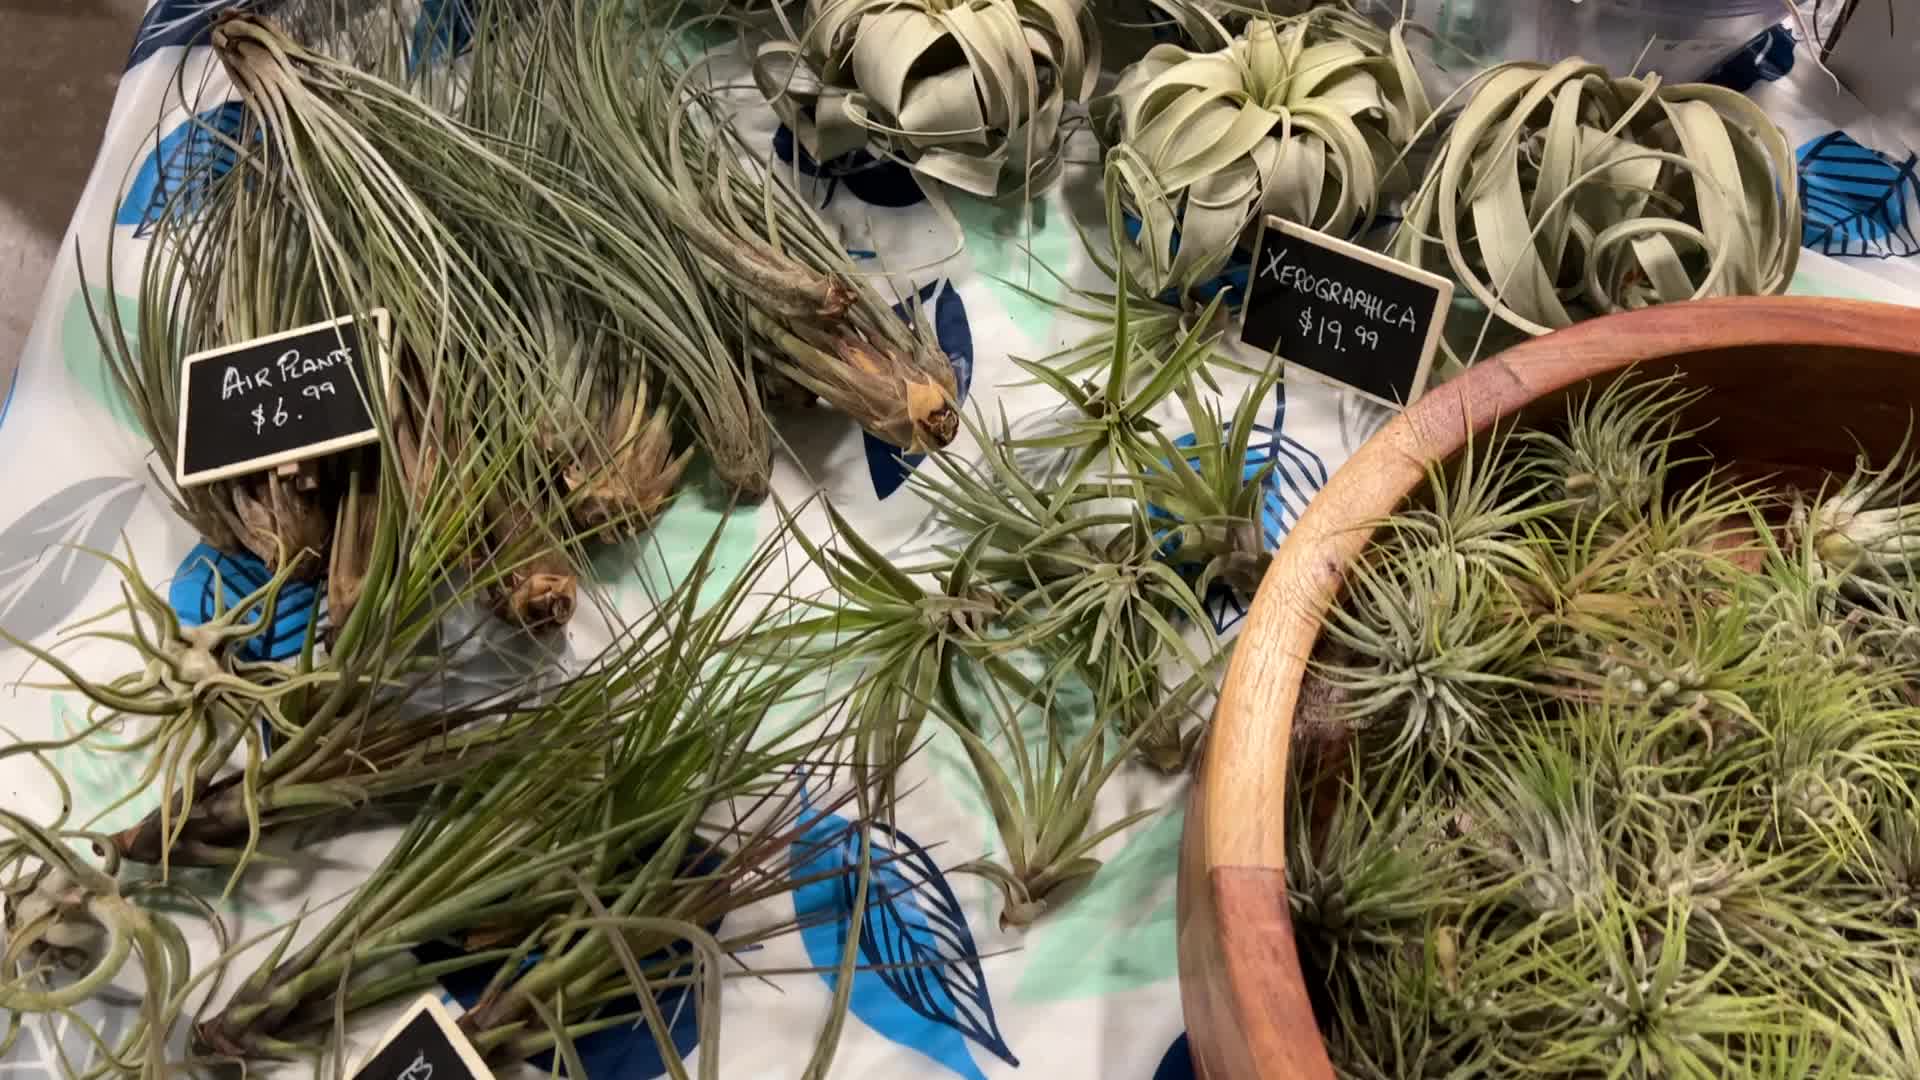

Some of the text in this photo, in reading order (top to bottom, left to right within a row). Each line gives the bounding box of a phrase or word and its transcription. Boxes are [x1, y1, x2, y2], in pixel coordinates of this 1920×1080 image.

[1259, 246, 1417, 333] XEROGRAPHICA
[1299, 306, 1379, 352] $19.99
[222, 366, 273, 400] AIR
[250, 381, 336, 435] $6.99
